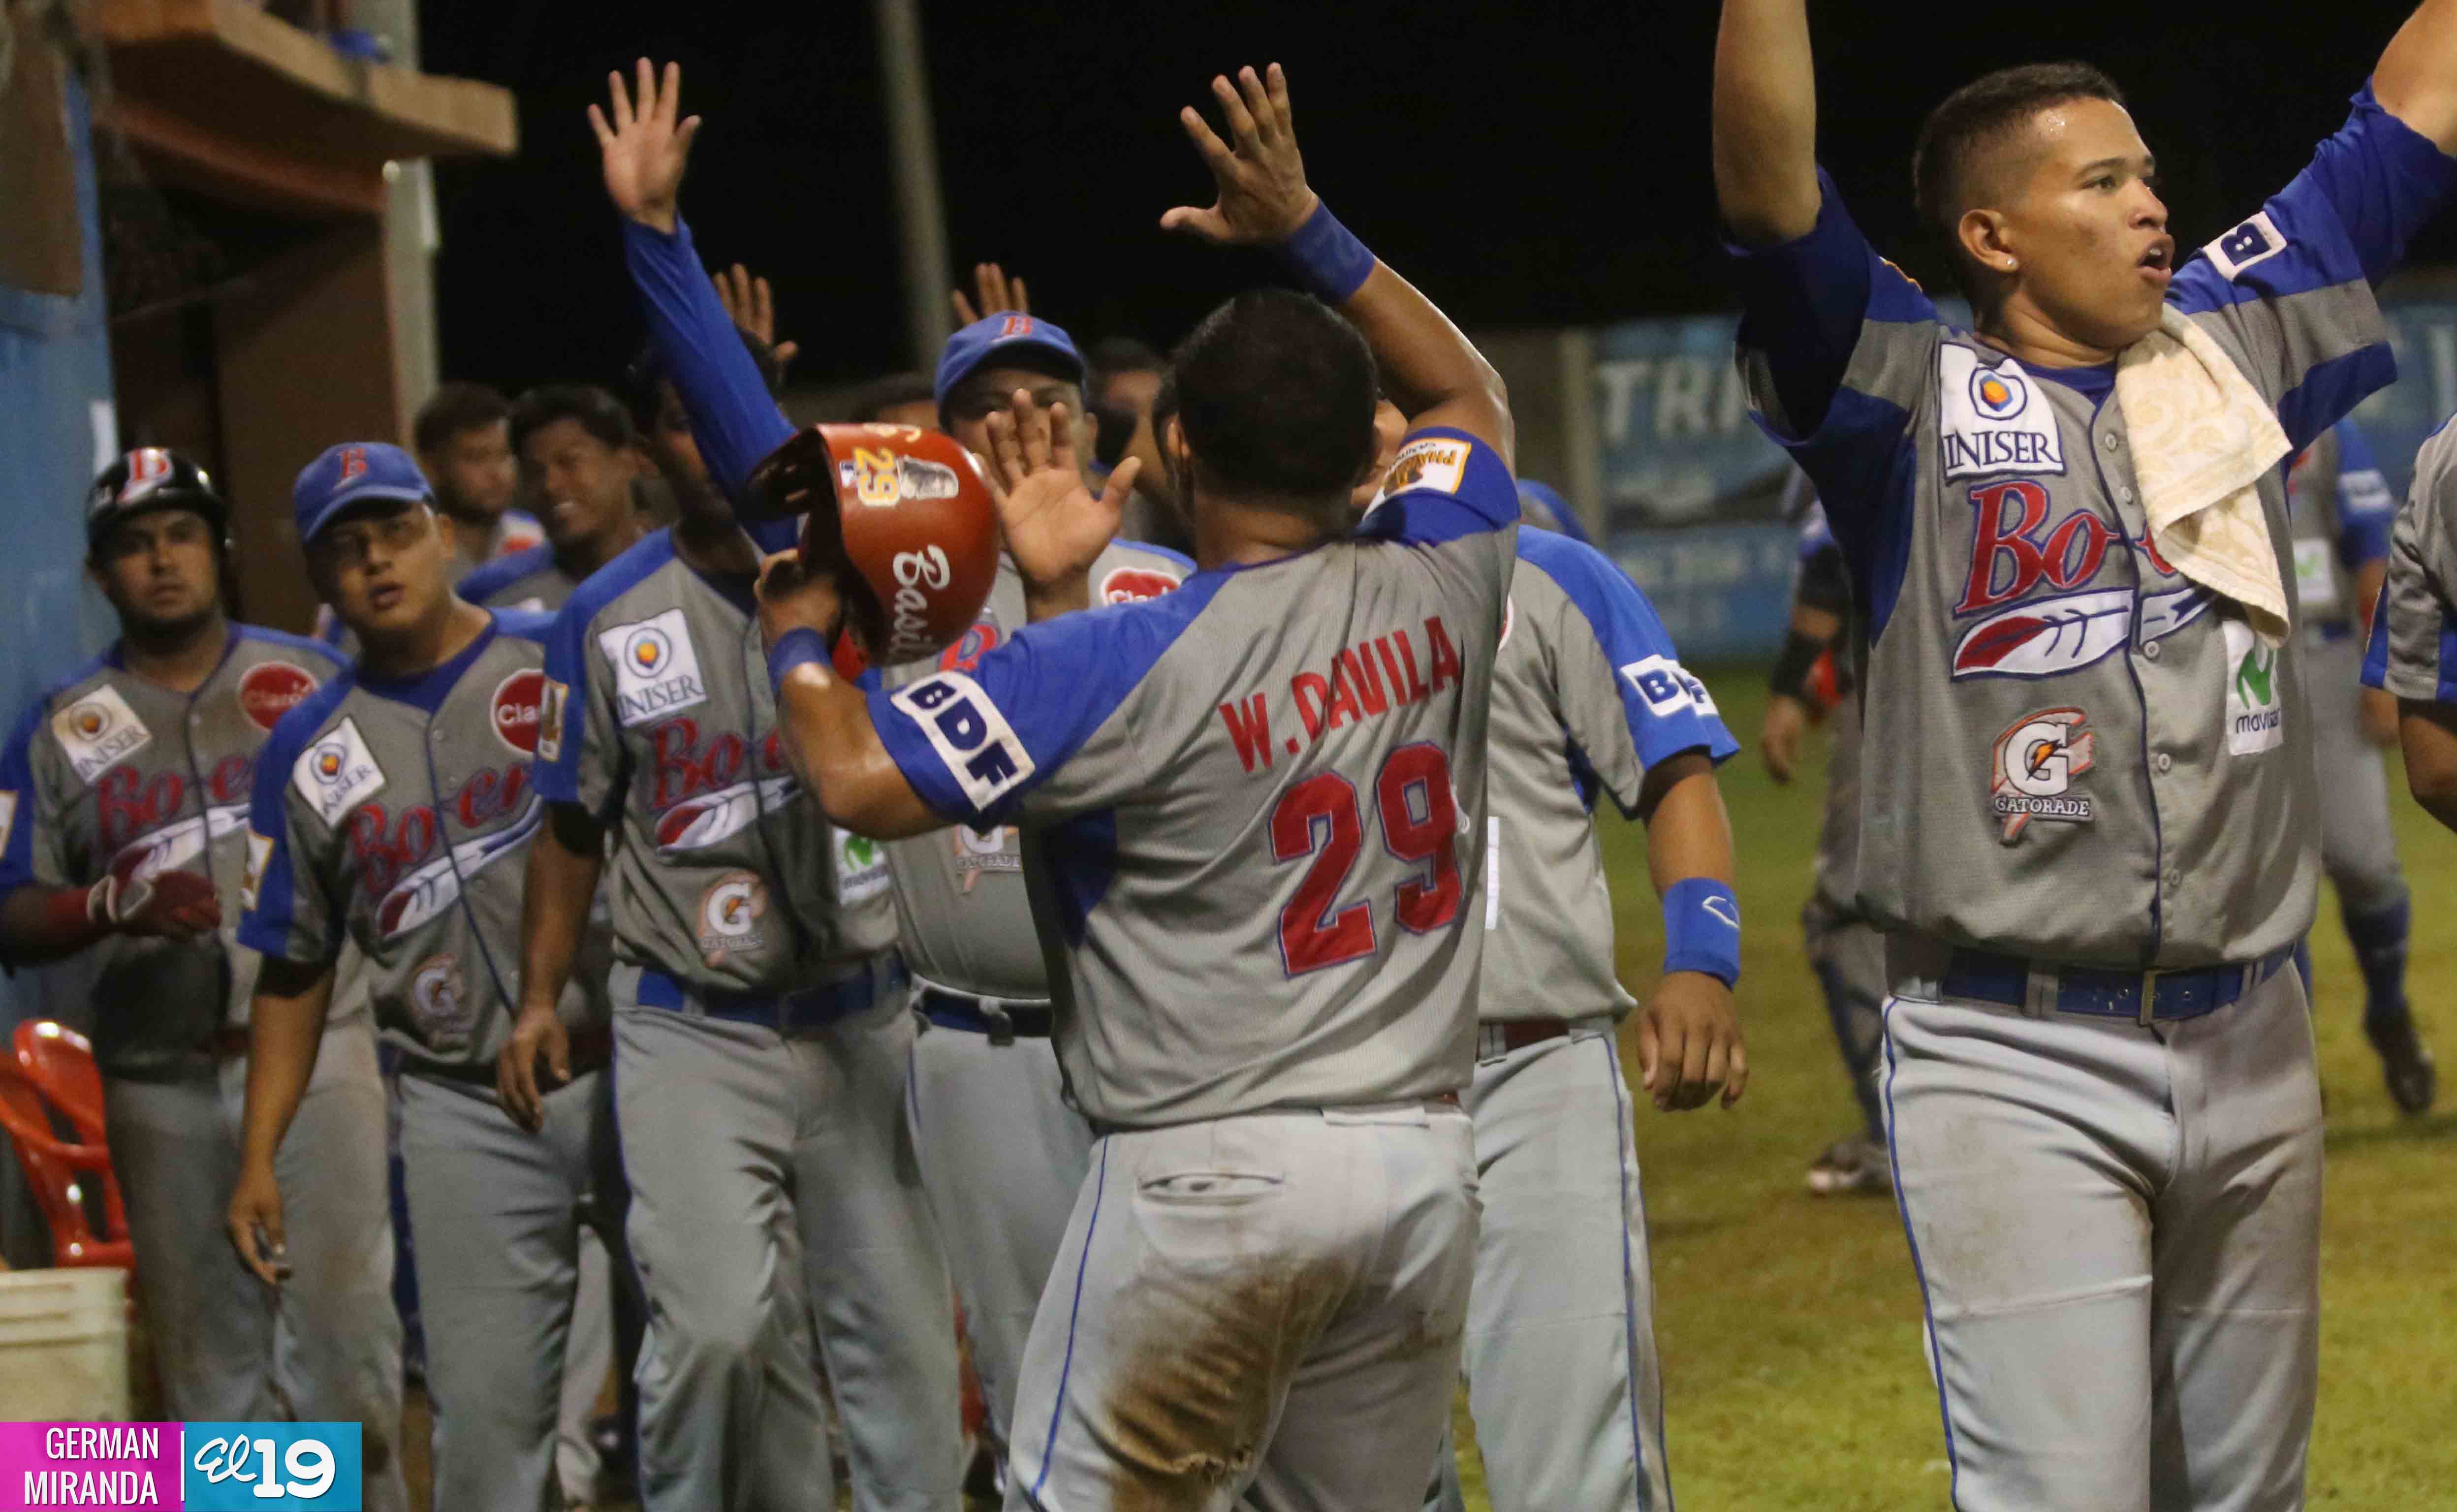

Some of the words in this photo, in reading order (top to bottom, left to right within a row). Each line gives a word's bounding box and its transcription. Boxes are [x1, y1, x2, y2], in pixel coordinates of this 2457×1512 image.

[1944, 428, 2053, 471] INISER
[498, 702, 540, 727] Cla
[616, 673, 705, 720] INISER
[907, 680, 1018, 787] BDF
[1994, 797, 2090, 818] GATORADE
[1268, 740, 1465, 980] 29
